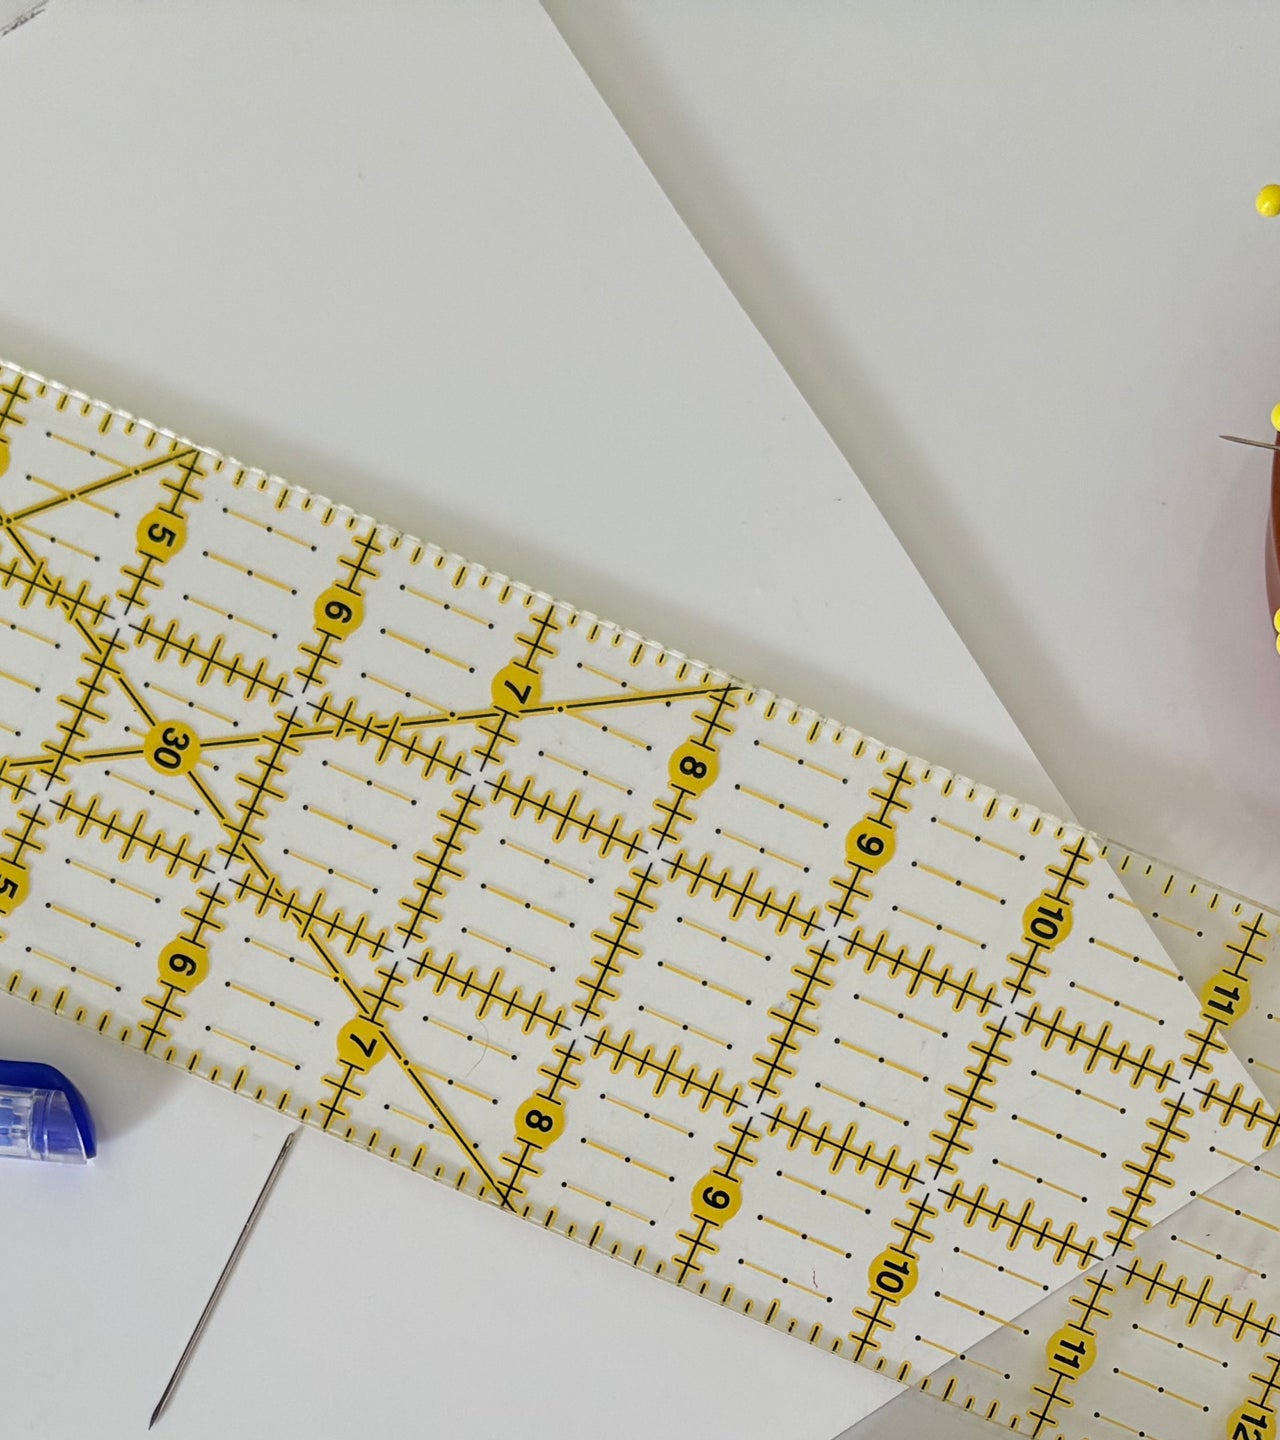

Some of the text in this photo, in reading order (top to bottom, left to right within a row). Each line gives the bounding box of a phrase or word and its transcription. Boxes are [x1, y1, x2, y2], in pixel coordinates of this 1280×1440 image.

[147, 523, 177, 548] 5
[324, 600, 353, 624] 6
[504, 679, 532, 705] 7
[153, 727, 190, 770] 30
[679, 755, 708, 779] 8
[856, 833, 885, 856] 9
[1030, 906, 1064, 940] 10
[168, 953, 197, 977] 6
[1207, 985, 1241, 1016] 11
[349, 1033, 378, 1058] 7
[525, 1109, 554, 1133] 8
[702, 1186, 730, 1210] 9
[875, 1259, 910, 1294] 10
[1053, 1339, 1087, 1370] 11
